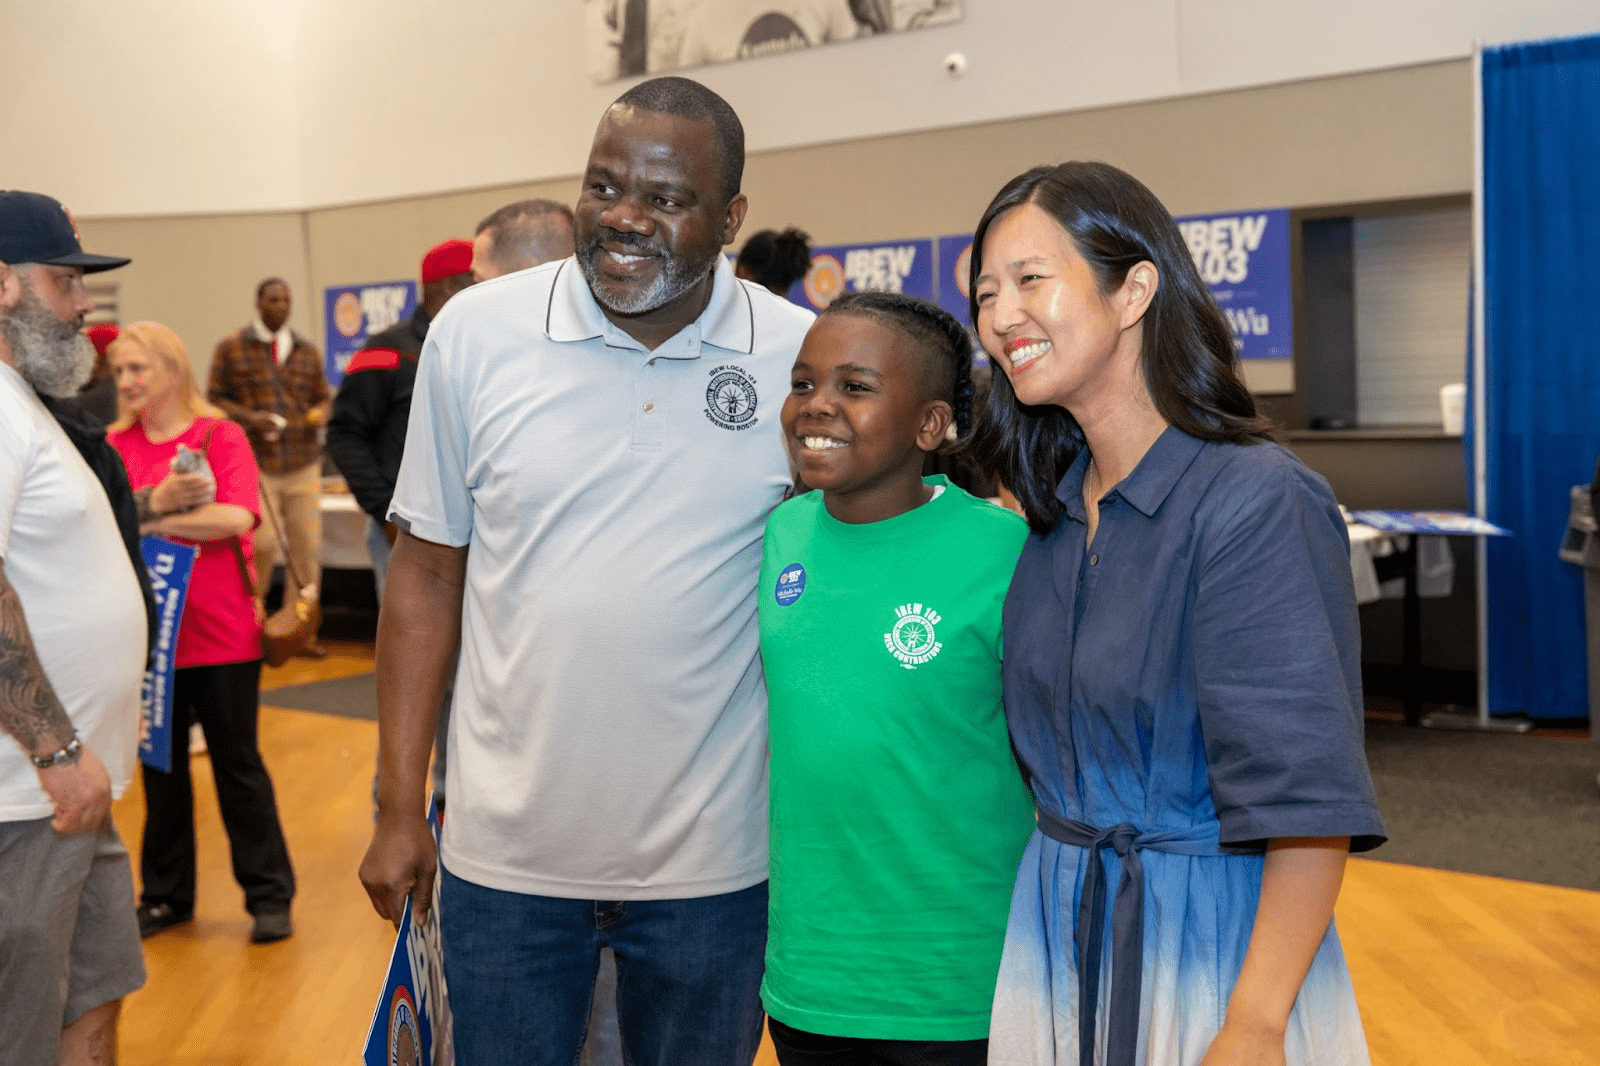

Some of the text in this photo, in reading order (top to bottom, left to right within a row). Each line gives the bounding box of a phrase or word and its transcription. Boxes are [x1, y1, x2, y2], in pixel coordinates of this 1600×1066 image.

[709, 365, 724, 376] IBEW
[726, 365, 747, 376] LOCAL
[703, 408, 735, 431] POWERING
[736, 416, 759, 431] BOSTON
[894, 602, 942, 625] IBEW 103
[893, 641, 943, 664] CONTRACTORS
